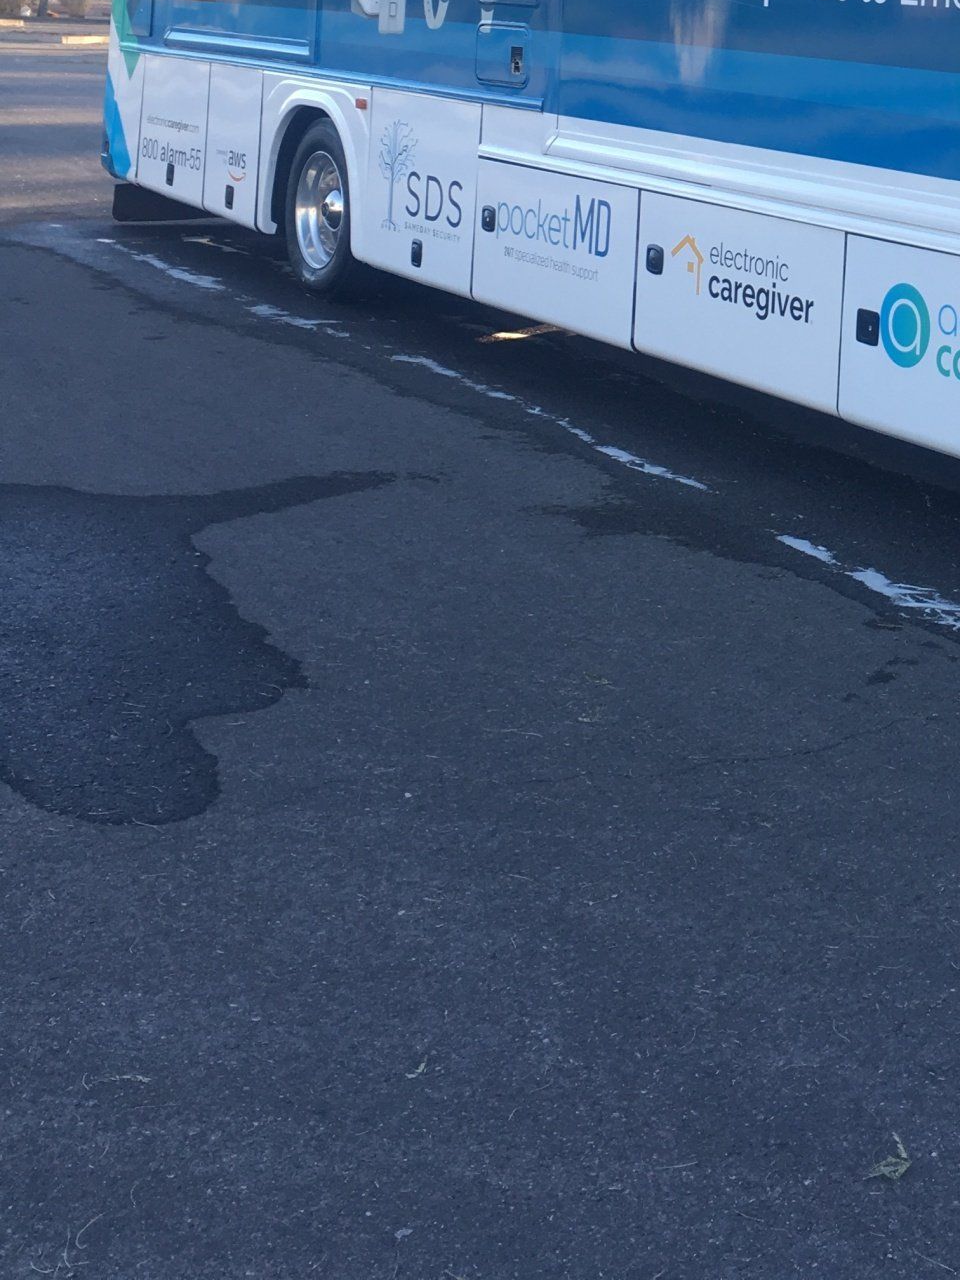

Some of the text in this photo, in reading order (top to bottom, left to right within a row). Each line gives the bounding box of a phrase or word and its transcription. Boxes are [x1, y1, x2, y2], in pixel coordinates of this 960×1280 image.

[141, 137, 159, 160] 800
[160, 141, 201, 171] alarm-55
[229, 150, 247, 169] aws
[405, 171, 463, 228] SDS
[496, 194, 612, 258] pocketMD
[709, 242, 789, 282] electronic
[708, 274, 815, 324] caregiver
